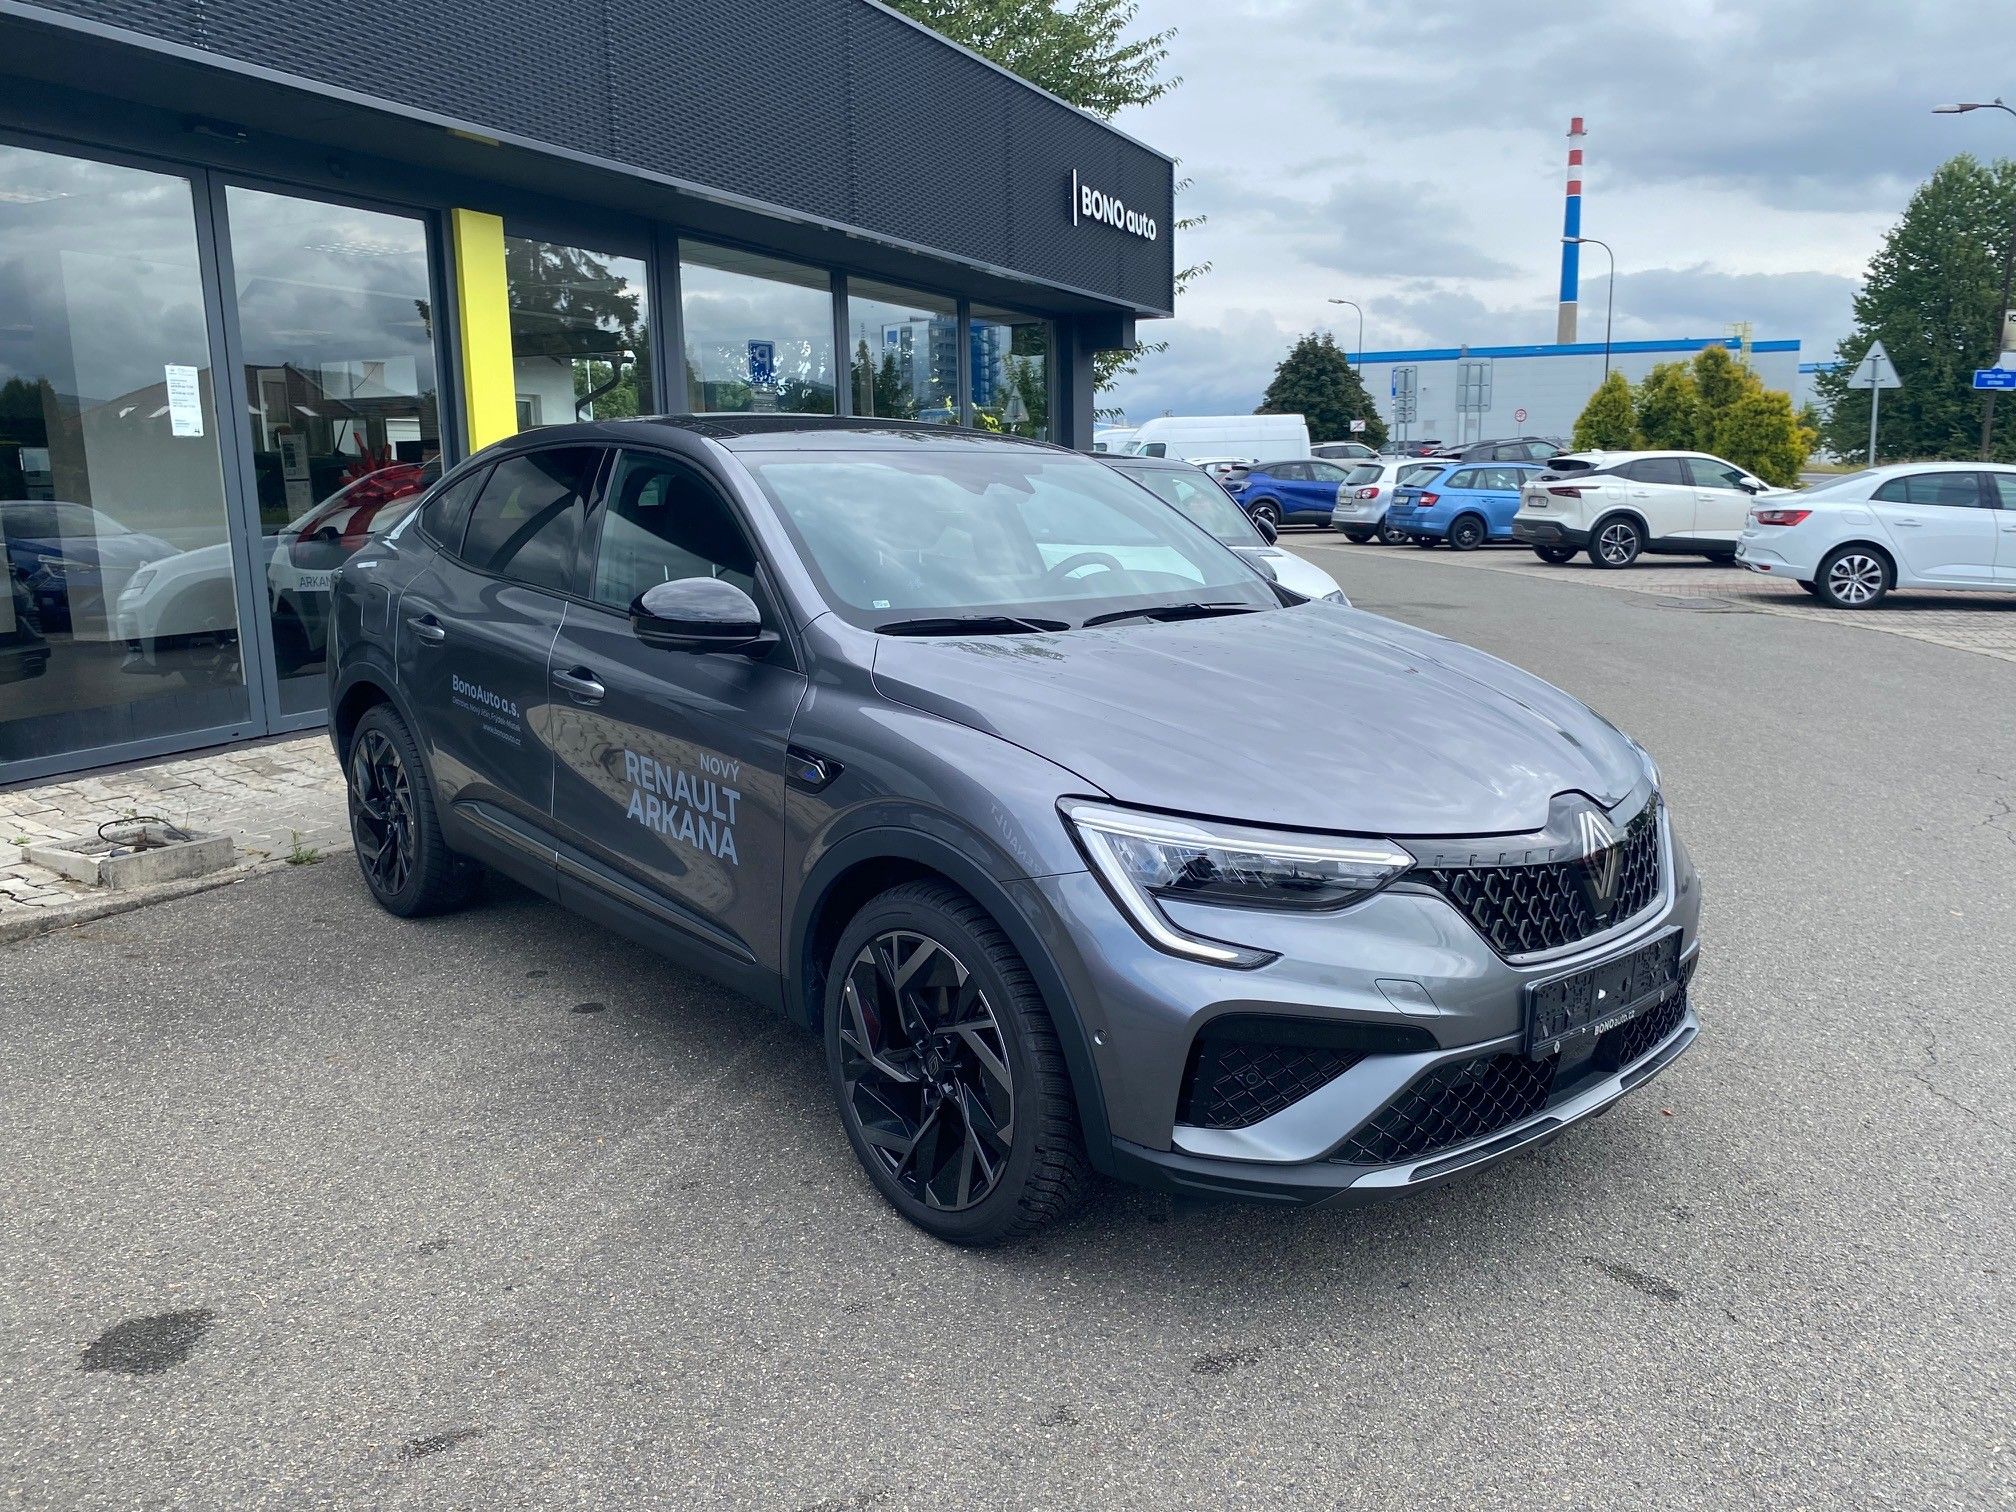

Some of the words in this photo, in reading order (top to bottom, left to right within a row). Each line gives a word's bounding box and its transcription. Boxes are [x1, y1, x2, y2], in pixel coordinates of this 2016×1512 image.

[452, 674, 500, 709] BonoAuto
[624, 749, 741, 825] RENAULT
[700, 753, 740, 782] NOVÝ
[626, 788, 739, 866] ARKANA
